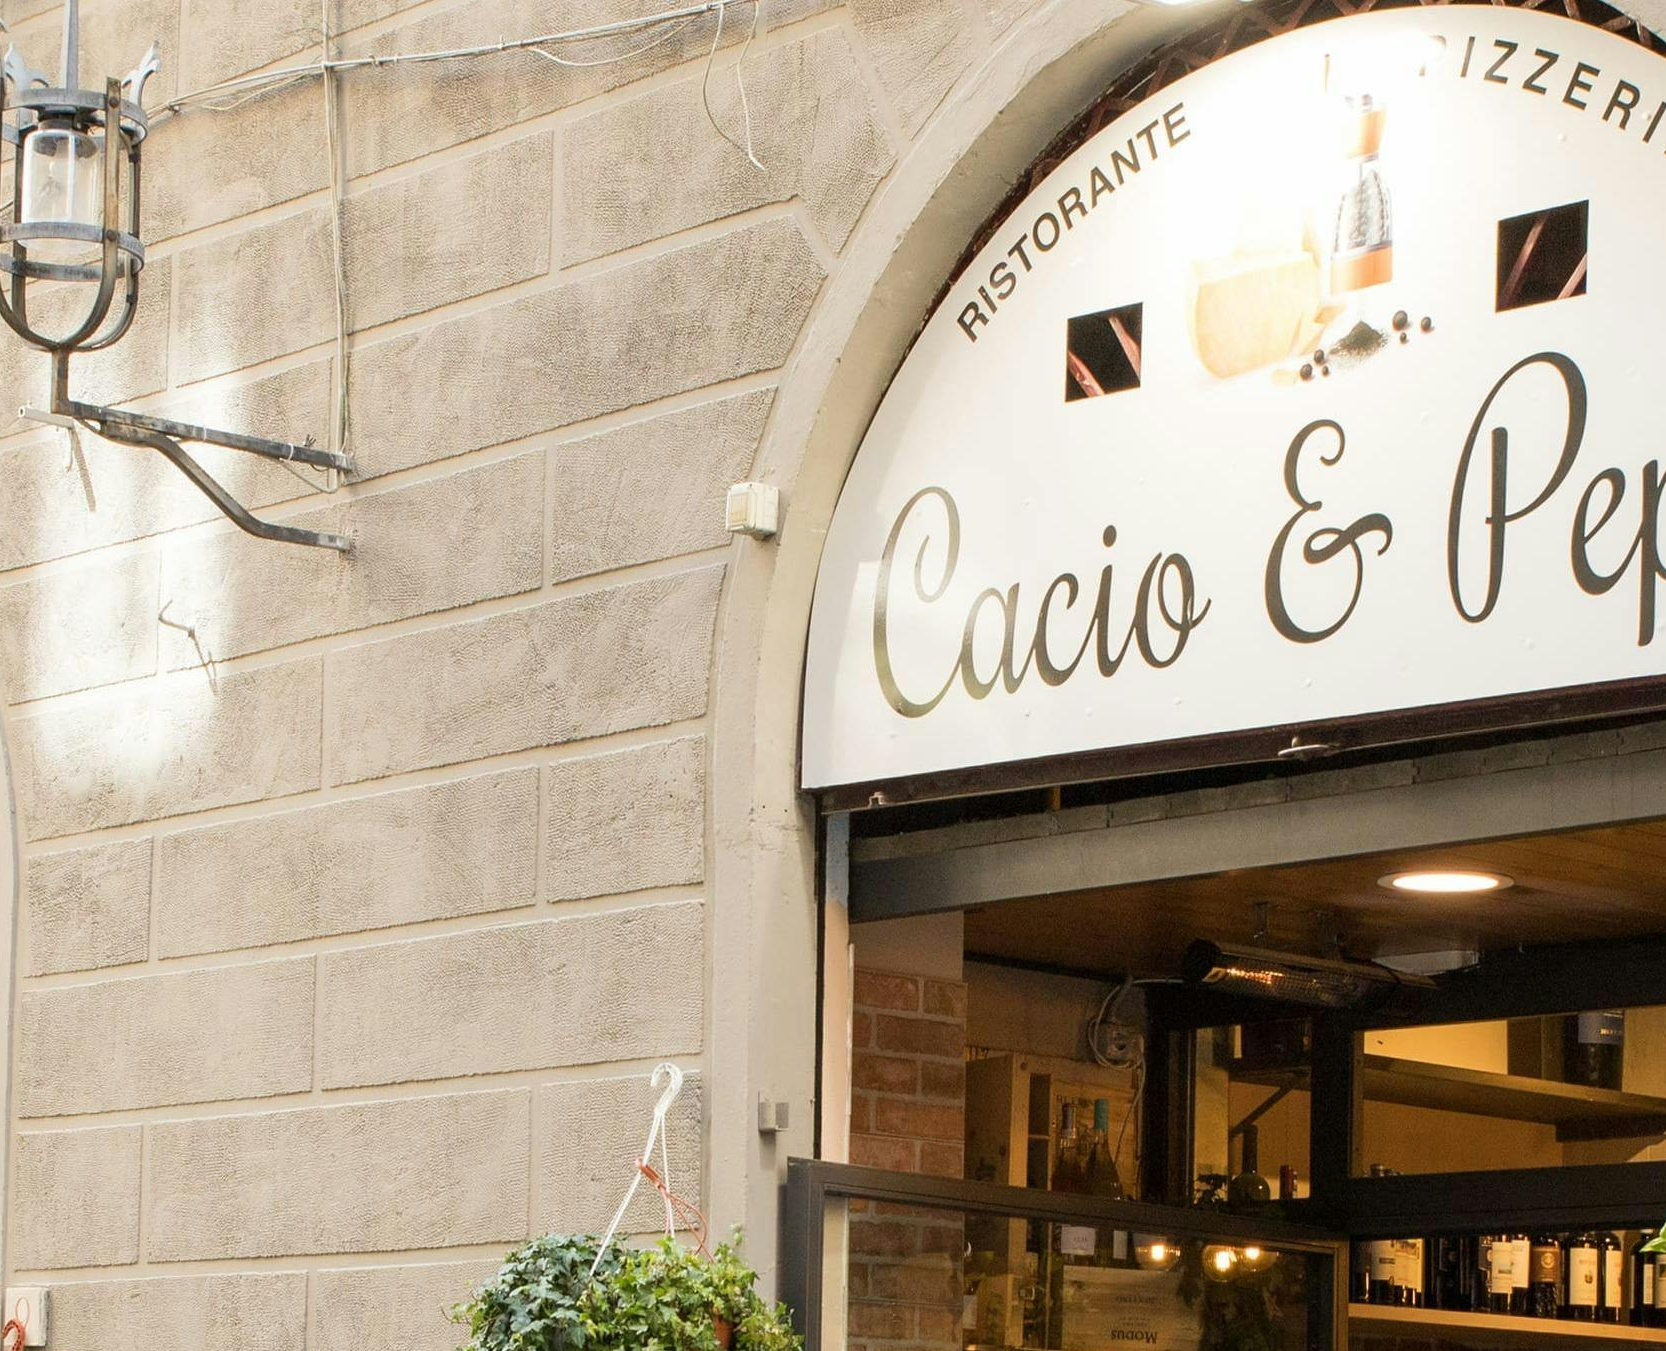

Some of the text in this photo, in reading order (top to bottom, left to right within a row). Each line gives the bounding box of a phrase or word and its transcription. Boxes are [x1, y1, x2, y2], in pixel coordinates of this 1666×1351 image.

[956, 101, 1192, 343] RISTORANTE
[873, 486, 1213, 719] Cacio
[1264, 419, 1394, 644] &
